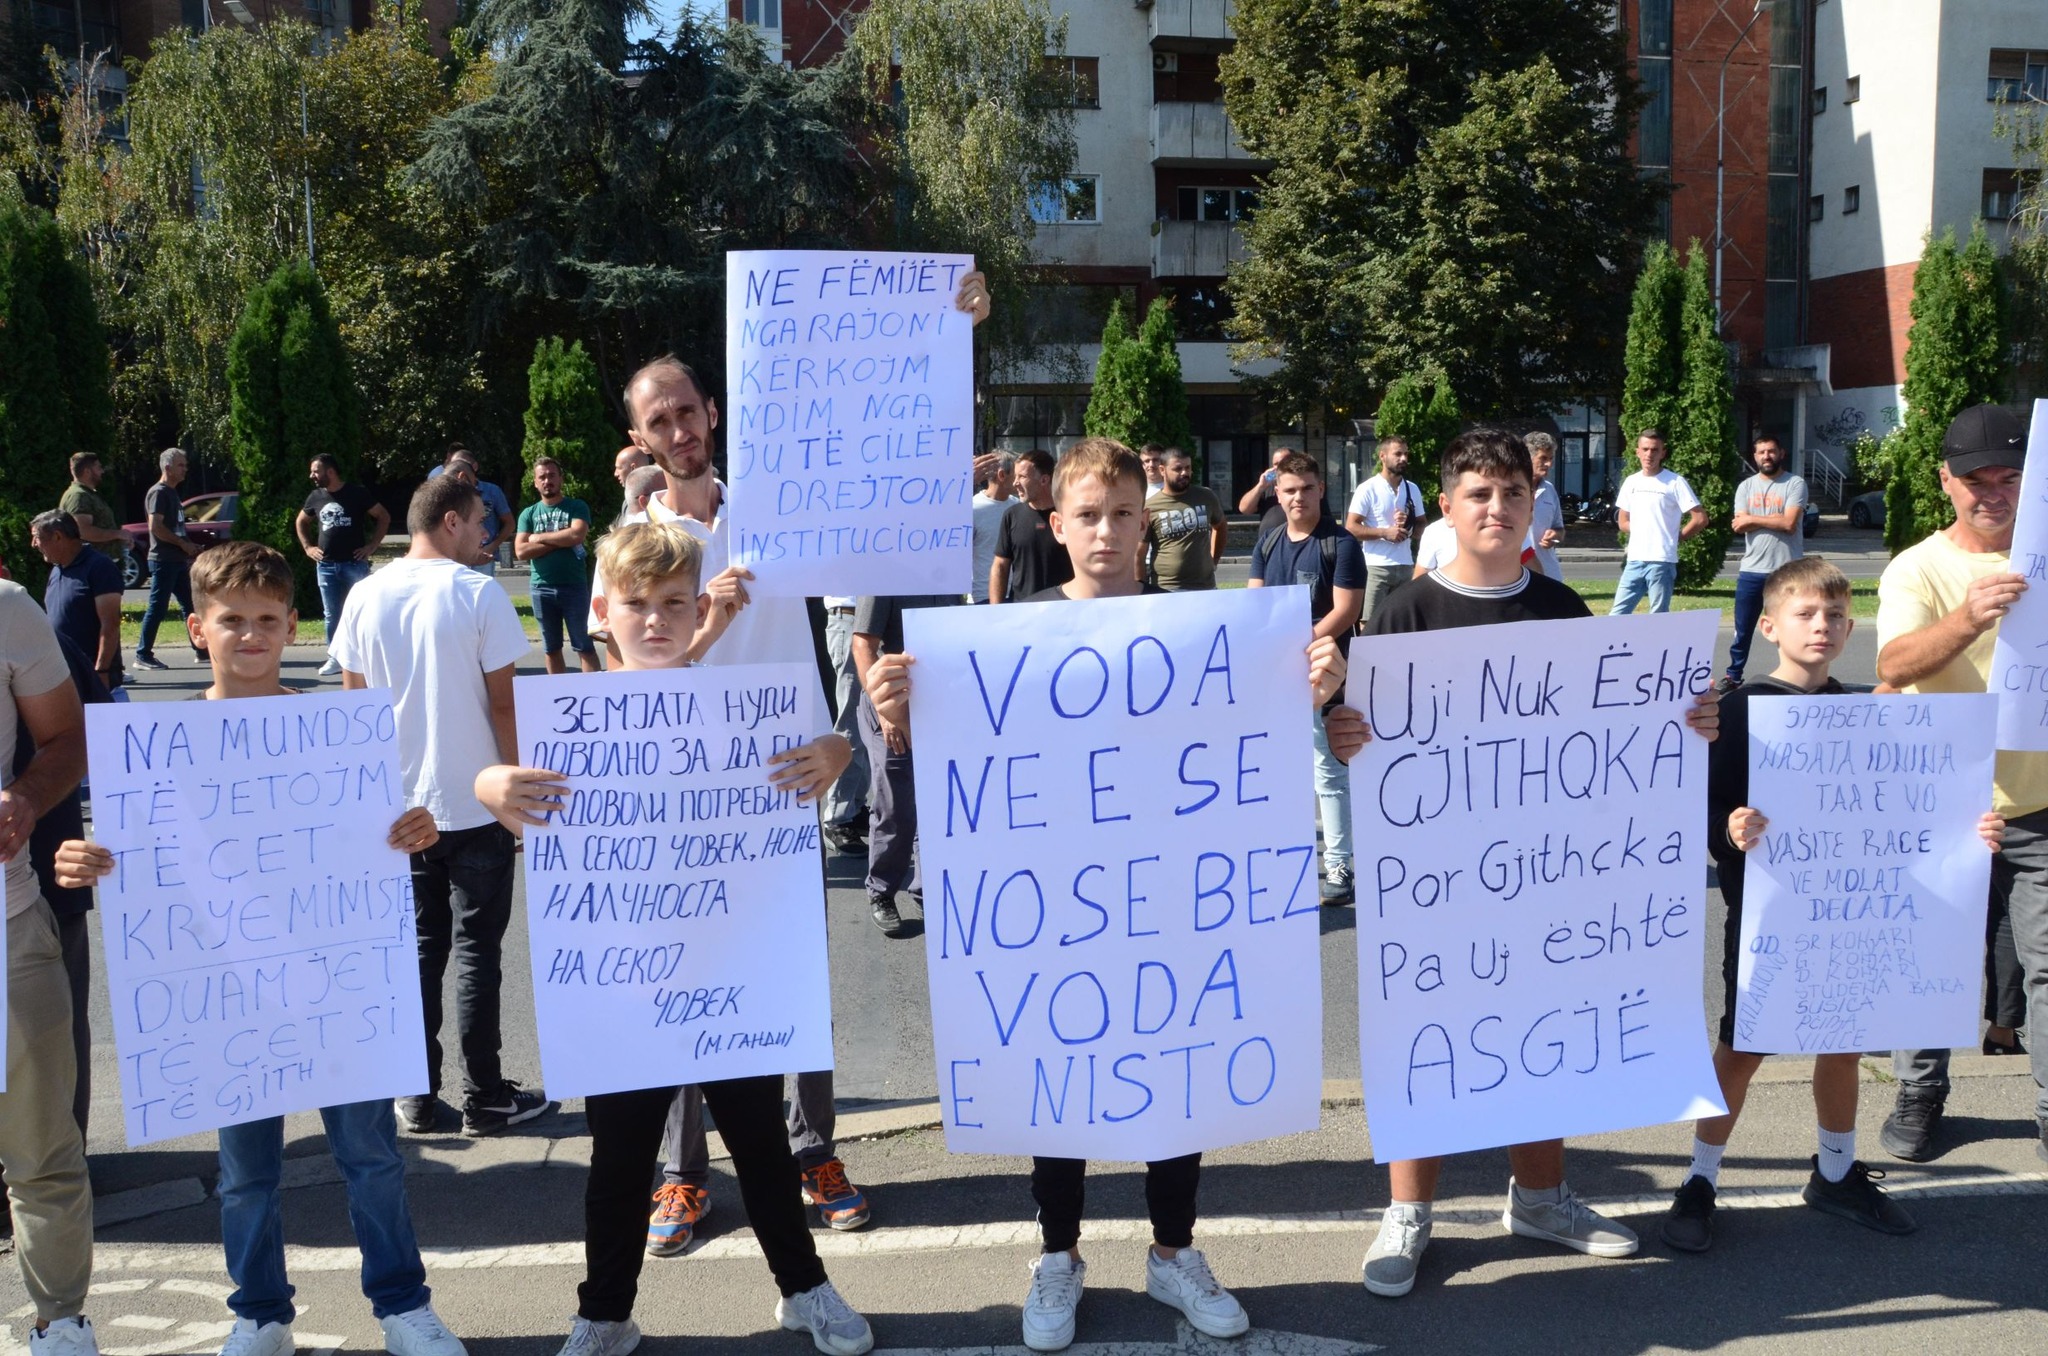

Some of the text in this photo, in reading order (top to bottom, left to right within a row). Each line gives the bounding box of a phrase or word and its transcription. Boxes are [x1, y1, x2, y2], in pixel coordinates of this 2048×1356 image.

[746, 269, 799, 309] NE
[742, 318, 797, 348] NGA
[863, 393, 932, 422] NGA
[735, 440, 782, 479] JU
[798, 430, 844, 470] TË
[968, 624, 1235, 736] VODA
[1370, 642, 1712, 746] Uji Nuk Është
[725, 685, 797, 731] НУДИ
[1786, 703, 1934, 730] SPASETE JA
[125, 721, 194, 774] NA
[669, 737, 711, 776] ЗА
[722, 735, 761, 771] ДА
[106, 761, 392, 829] TË JETOJM
[945, 731, 1269, 837] NE E SE
[1874, 781, 1888, 812] E
[1904, 783, 1936, 813] VO
[109, 823, 335, 893] TË ÇET
[533, 835, 567, 872] НА
[1862, 828, 1933, 857] RACE
[1377, 855, 1463, 917] Por
[1790, 866, 1908, 895] VE MOLAT
[547, 948, 587, 986] НА
[1380, 892, 1689, 999] Pa Uj është
[134, 962, 288, 1034] DUAM
[654, 985, 745, 1028] ЧОВЕК
[974, 949, 1243, 1047] VODA
[127, 1032, 199, 1098] TË
[1408, 988, 1655, 1106] ASGJË
[951, 1035, 1276, 1128] E NISTO
[132, 1083, 198, 1138] TË
